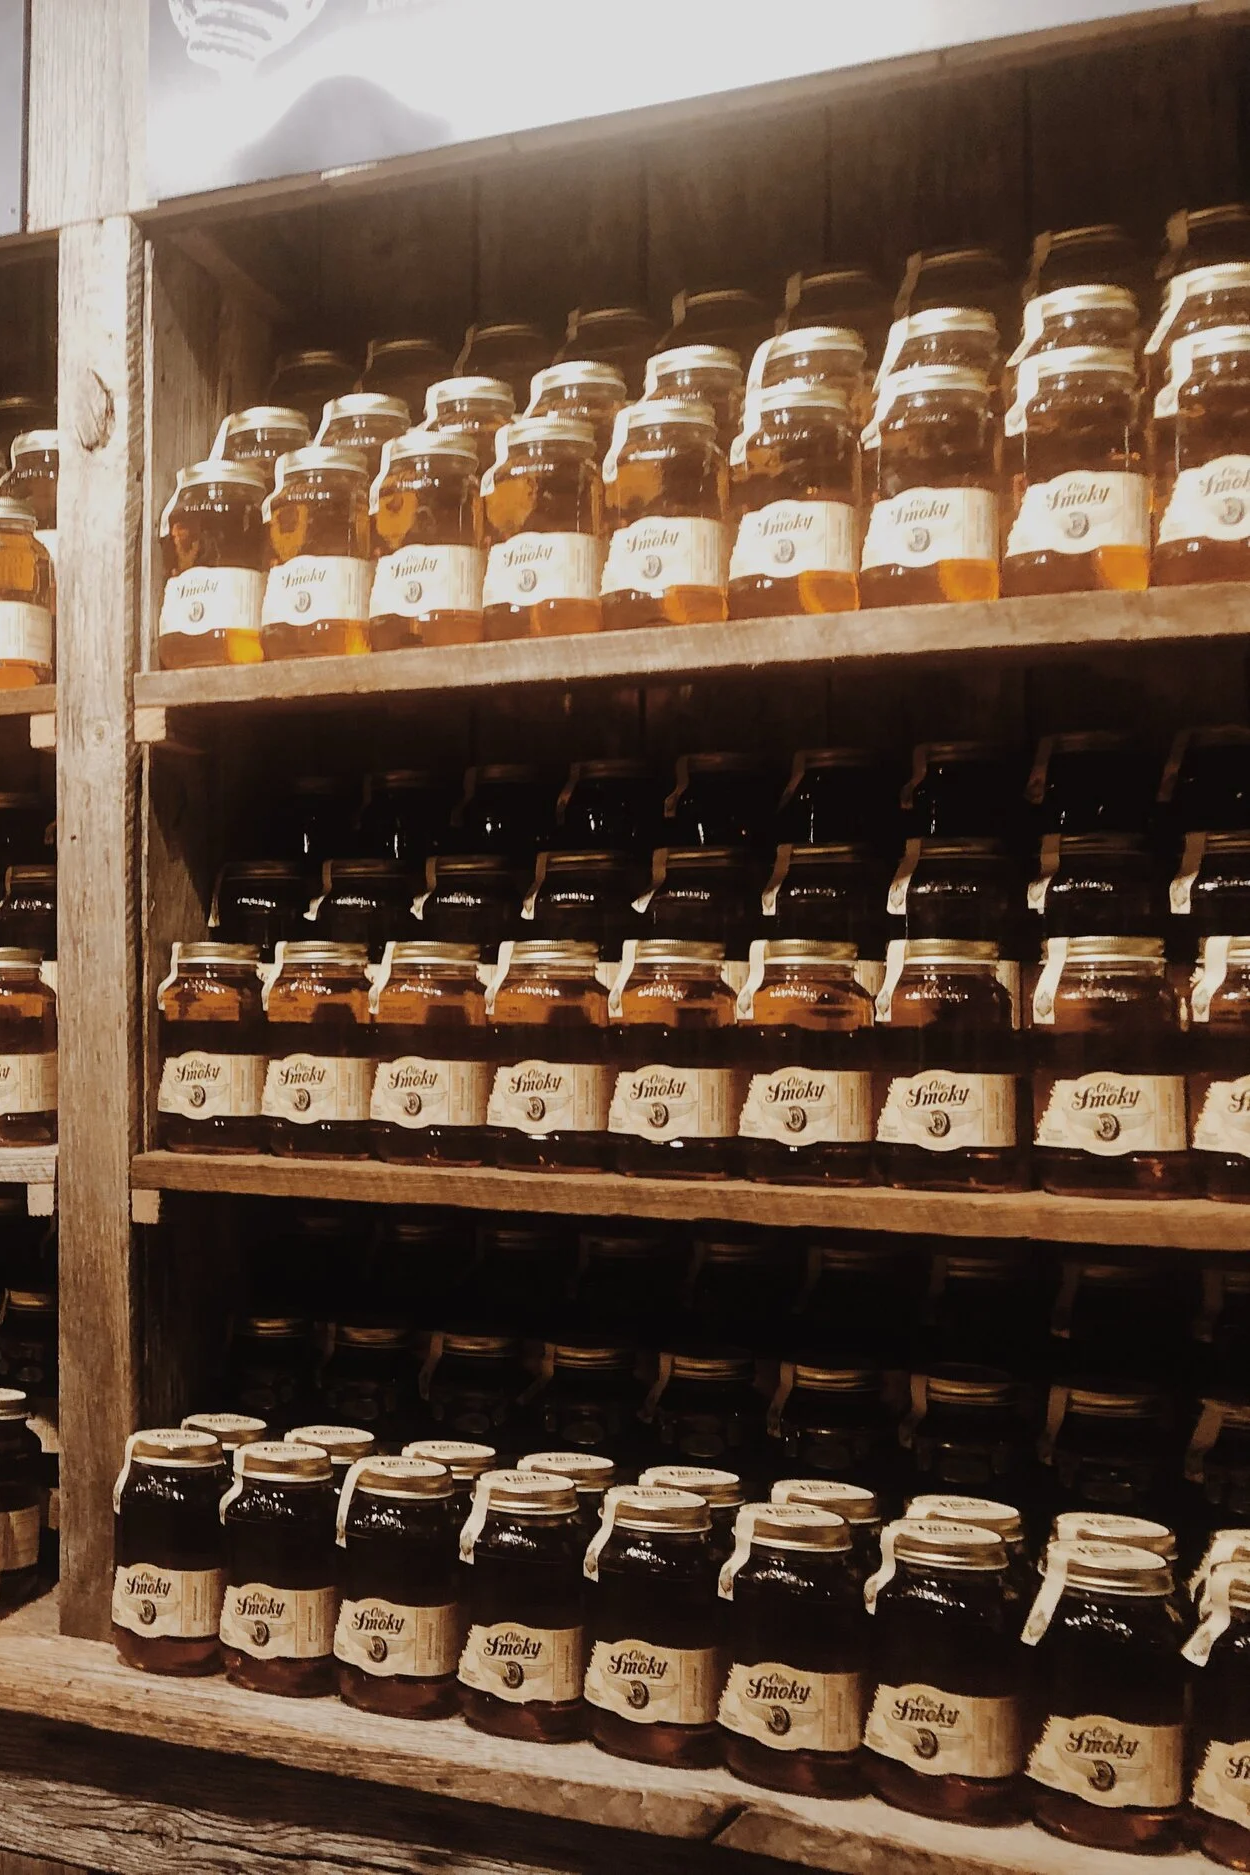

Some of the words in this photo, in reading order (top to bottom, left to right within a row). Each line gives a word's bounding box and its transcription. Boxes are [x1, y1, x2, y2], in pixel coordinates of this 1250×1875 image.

[174, 1063, 220, 1082] Smoky
[278, 1066, 326, 1085] Smoky
[388, 1069, 438, 1089] Smoky
[508, 1073, 562, 1093] Smoky
[630, 1078, 686, 1100] Smoky
[765, 1081, 825, 1103] Smoky
[906, 1085, 970, 1108] Smoky
[1071, 1086, 1140, 1110] Smoky
[125, 1577, 171, 1598] Smoky
[235, 1597, 285, 1618] Smoky
[351, 1611, 405, 1634] Smoky
[484, 1636, 541, 1659] Smoky
[607, 1654, 668, 1679] Smoky
[745, 1676, 811, 1704] Smoky
[892, 1698, 959, 1728] Smoky
[1065, 1730, 1139, 1760] Smoky
